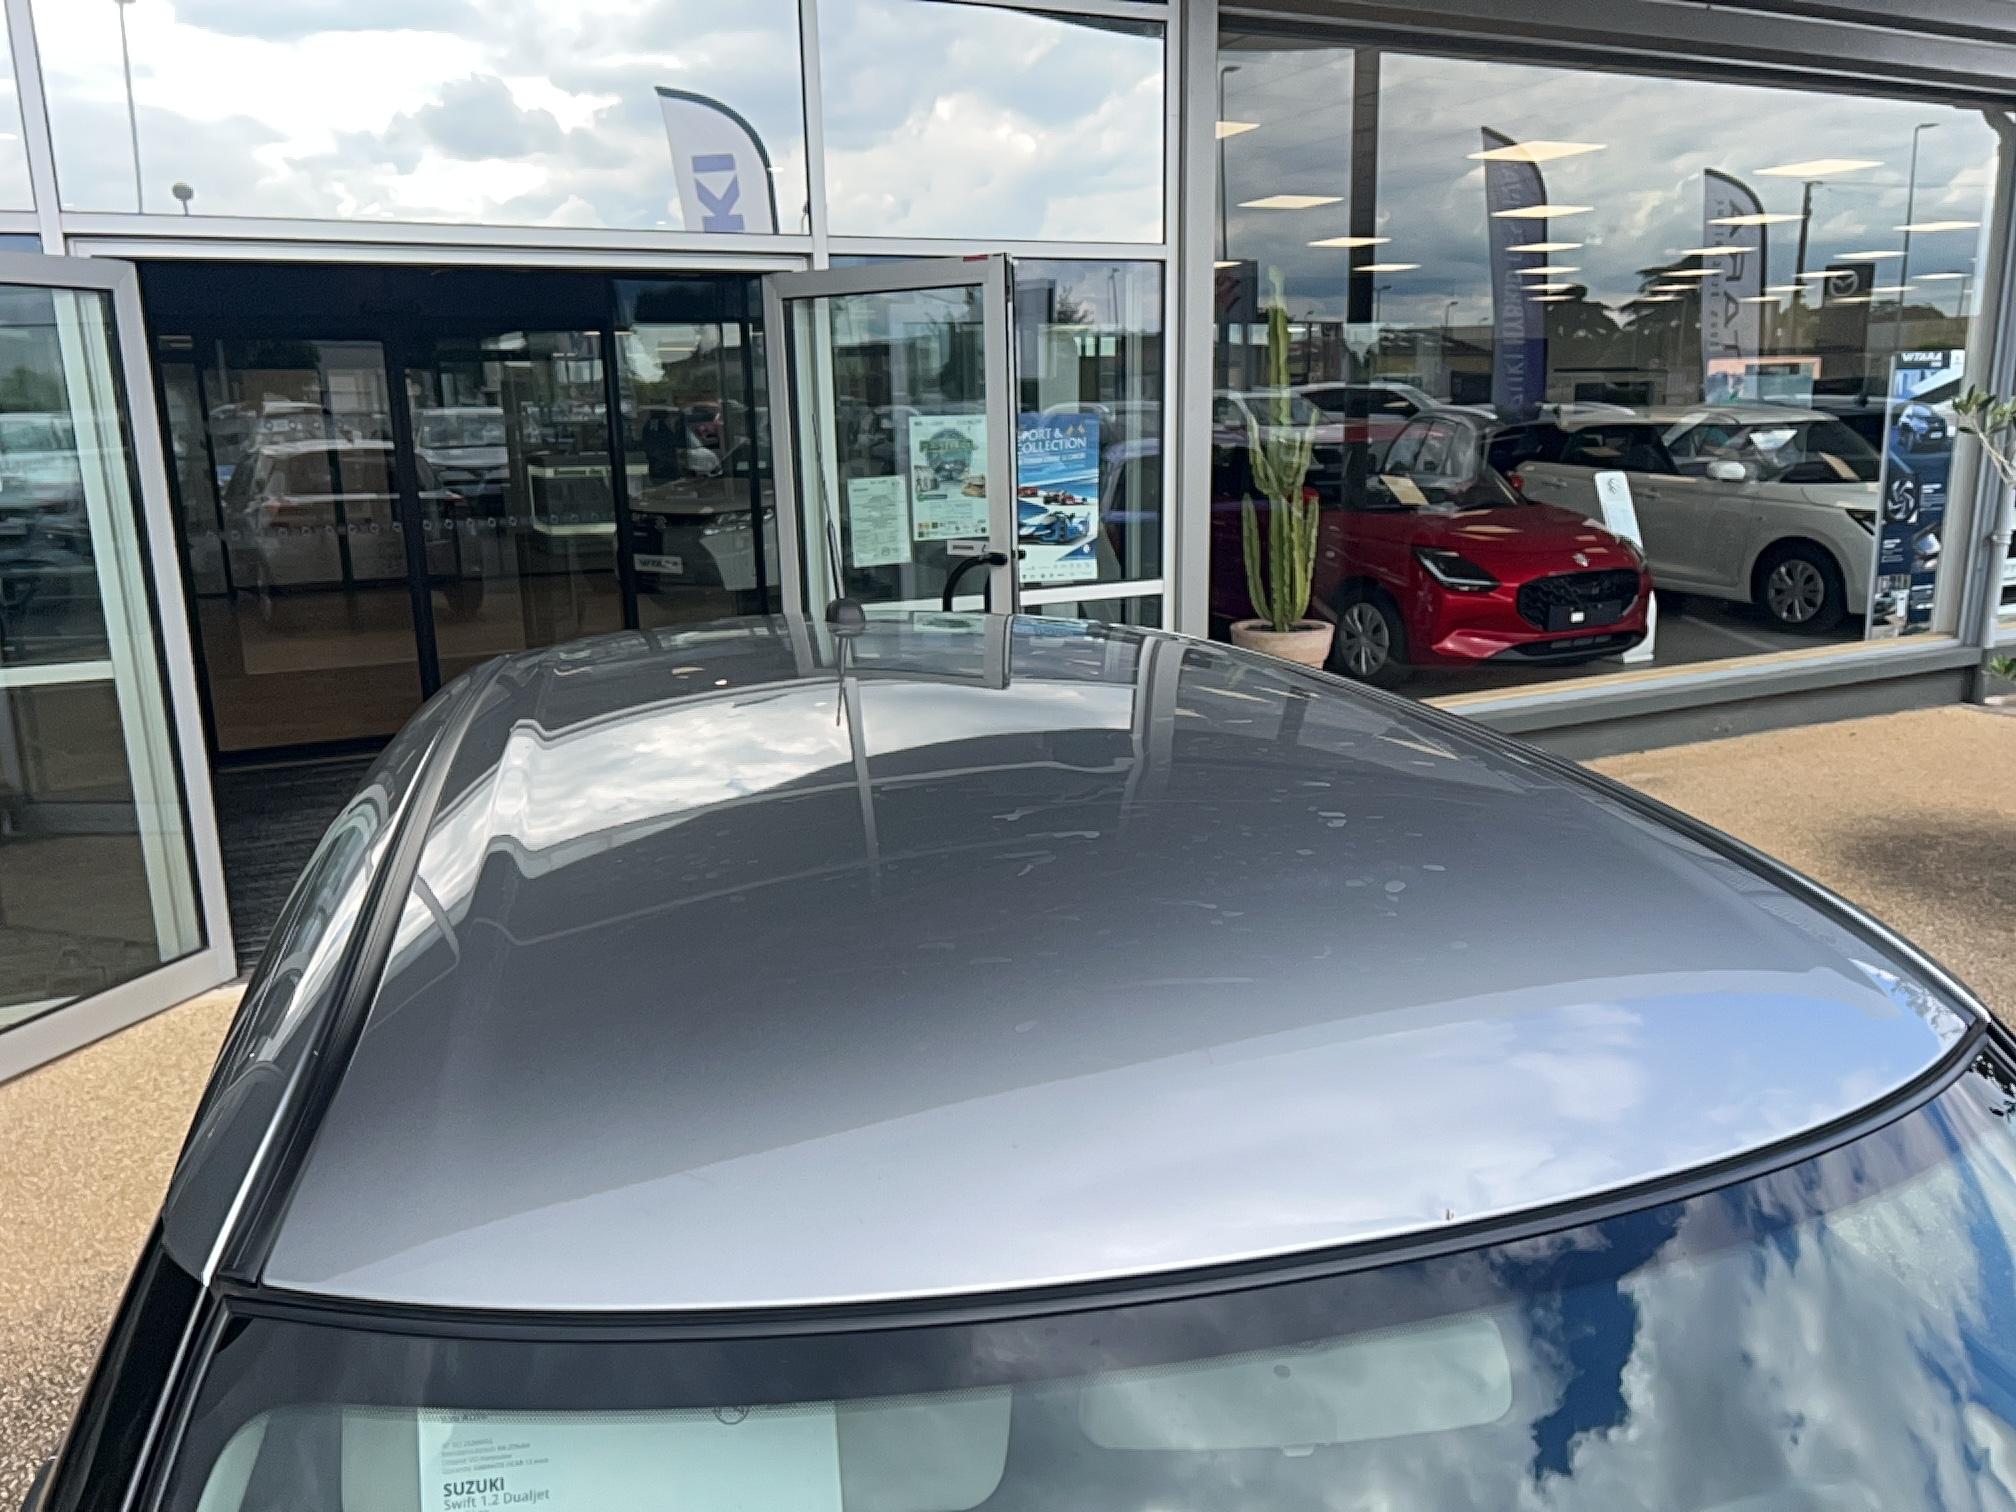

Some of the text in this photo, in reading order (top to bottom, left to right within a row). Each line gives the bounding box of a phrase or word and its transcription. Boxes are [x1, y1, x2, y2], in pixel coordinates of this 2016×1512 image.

[1054, 428, 1064, 439] &
[443, 1477, 504, 1497] SUZUKI
[444, 1489, 550, 1511] Swift 1.2 Dualjet
